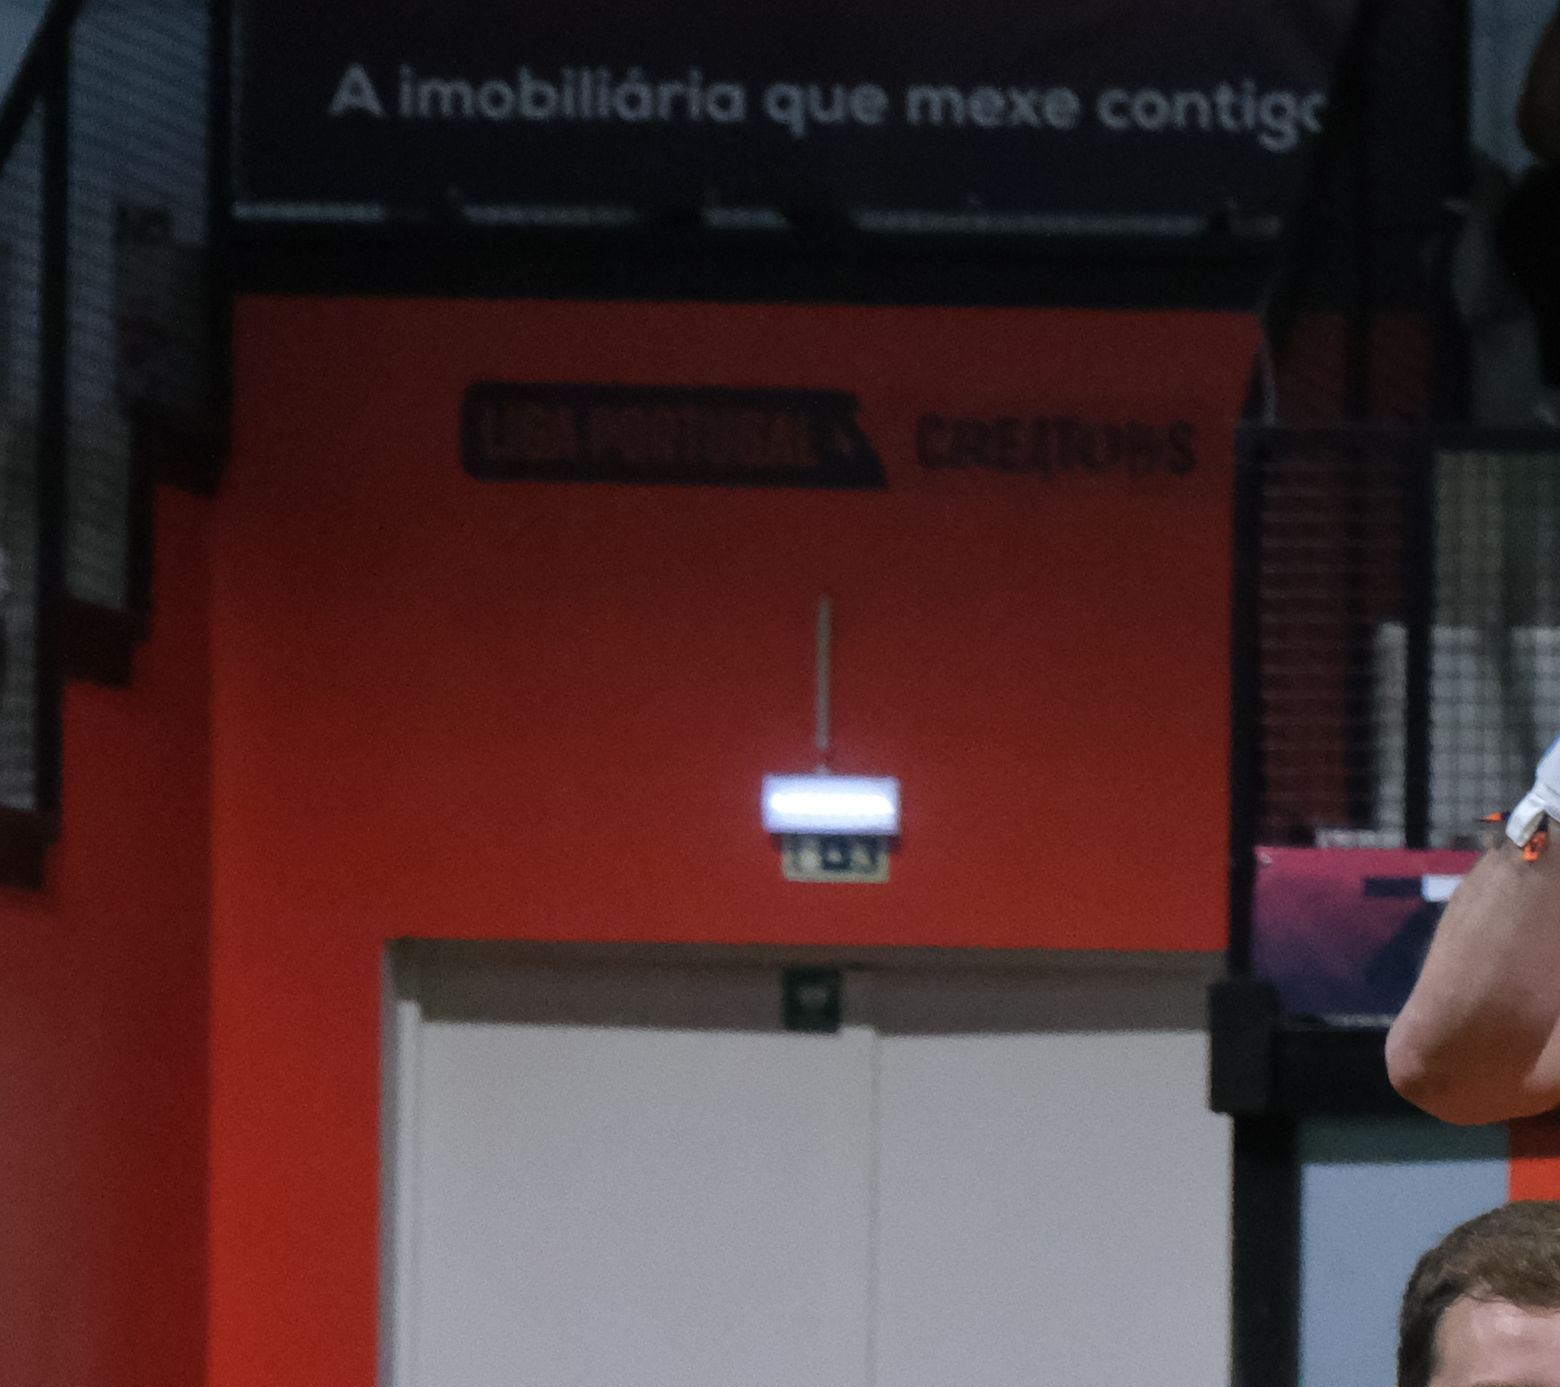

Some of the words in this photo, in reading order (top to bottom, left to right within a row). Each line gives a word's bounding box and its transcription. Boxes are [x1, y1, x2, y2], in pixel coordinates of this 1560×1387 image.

[327, 62, 384, 120] A
[397, 65, 747, 124] imobiliária
[762, 79, 889, 139] que
[905, 81, 1082, 130] mexe
